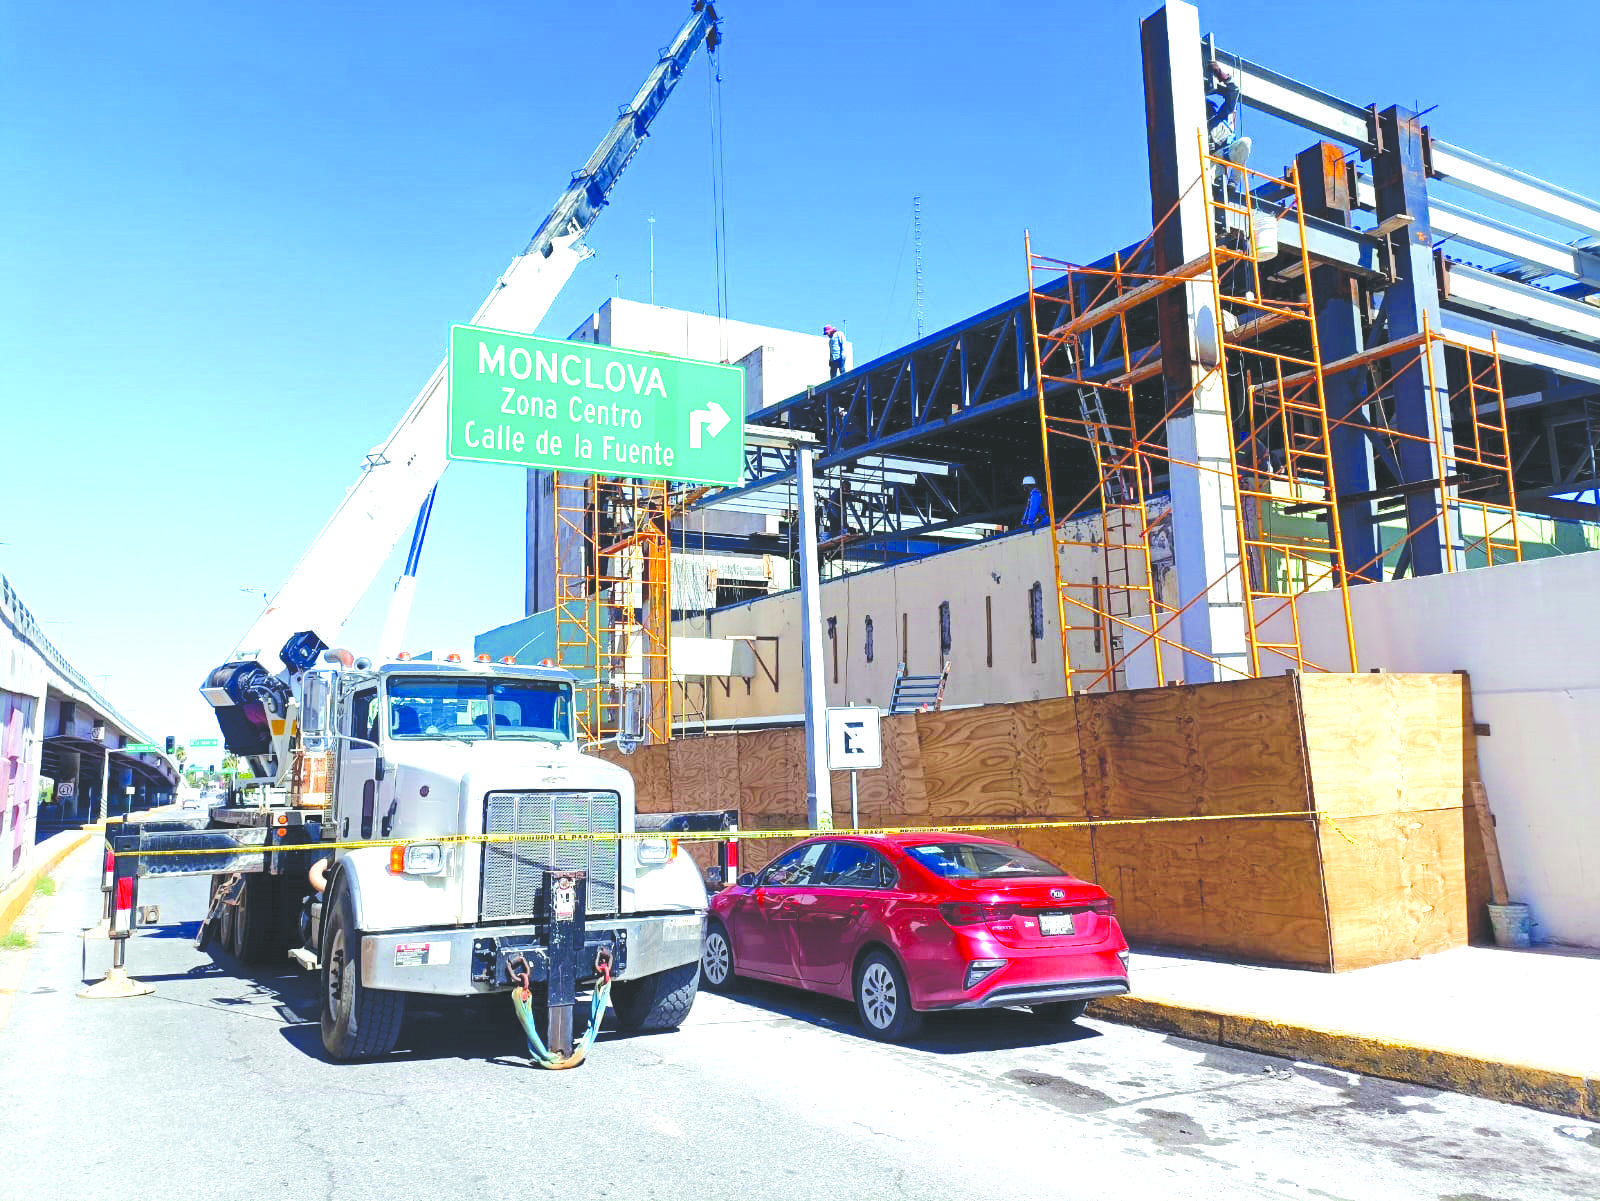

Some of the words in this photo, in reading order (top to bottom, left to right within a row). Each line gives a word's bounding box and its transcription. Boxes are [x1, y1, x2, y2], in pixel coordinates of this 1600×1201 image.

[478, 341, 667, 399] MONCLOVA
[500, 387, 557, 419] Zona
[569, 396, 642, 429] Centro
[464, 420, 525, 452] Calle
[536, 430, 563, 456] de
[575, 433, 593, 460] la
[603, 436, 674, 467] Fuente
